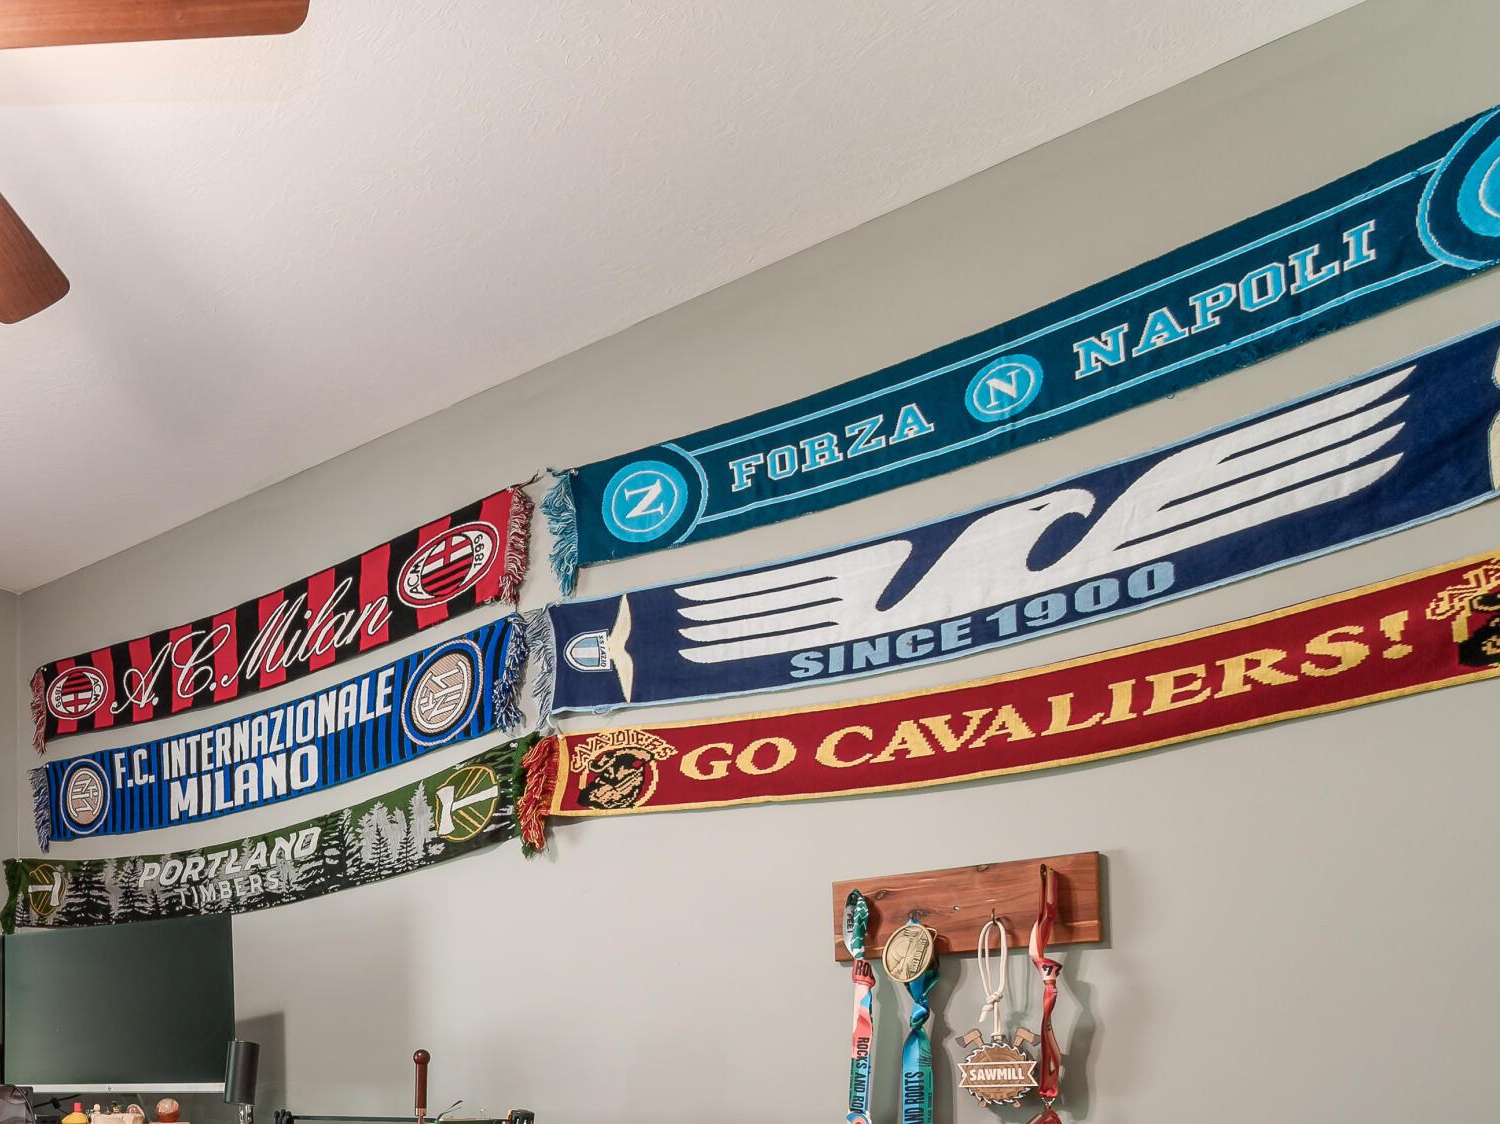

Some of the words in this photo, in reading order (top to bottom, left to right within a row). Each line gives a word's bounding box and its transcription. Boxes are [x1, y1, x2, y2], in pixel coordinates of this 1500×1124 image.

[729, 403, 935, 492] FORZA
[1073, 219, 1377, 379] NAPOLI
[473, 533, 485, 569] 1899
[221, 577, 393, 687] Milan
[790, 616, 973, 679] SINCE
[985, 561, 1176, 638] 1900
[679, 737, 797, 780] GO
[815, 610, 1413, 768] CAVALIERS!
[114, 749, 155, 789] F.C.
[162, 667, 395, 780] INTERNAZIONALE
[170, 744, 319, 821] MILANO
[138, 826, 322, 888] PORTLAND
[173, 870, 279, 907] TIMBERS
[854, 1072, 867, 1093] AND
[855, 1037, 870, 1069] ROCKS
[969, 1067, 1025, 1081] SAWMILL
[904, 1071, 925, 1105] ROOTS
